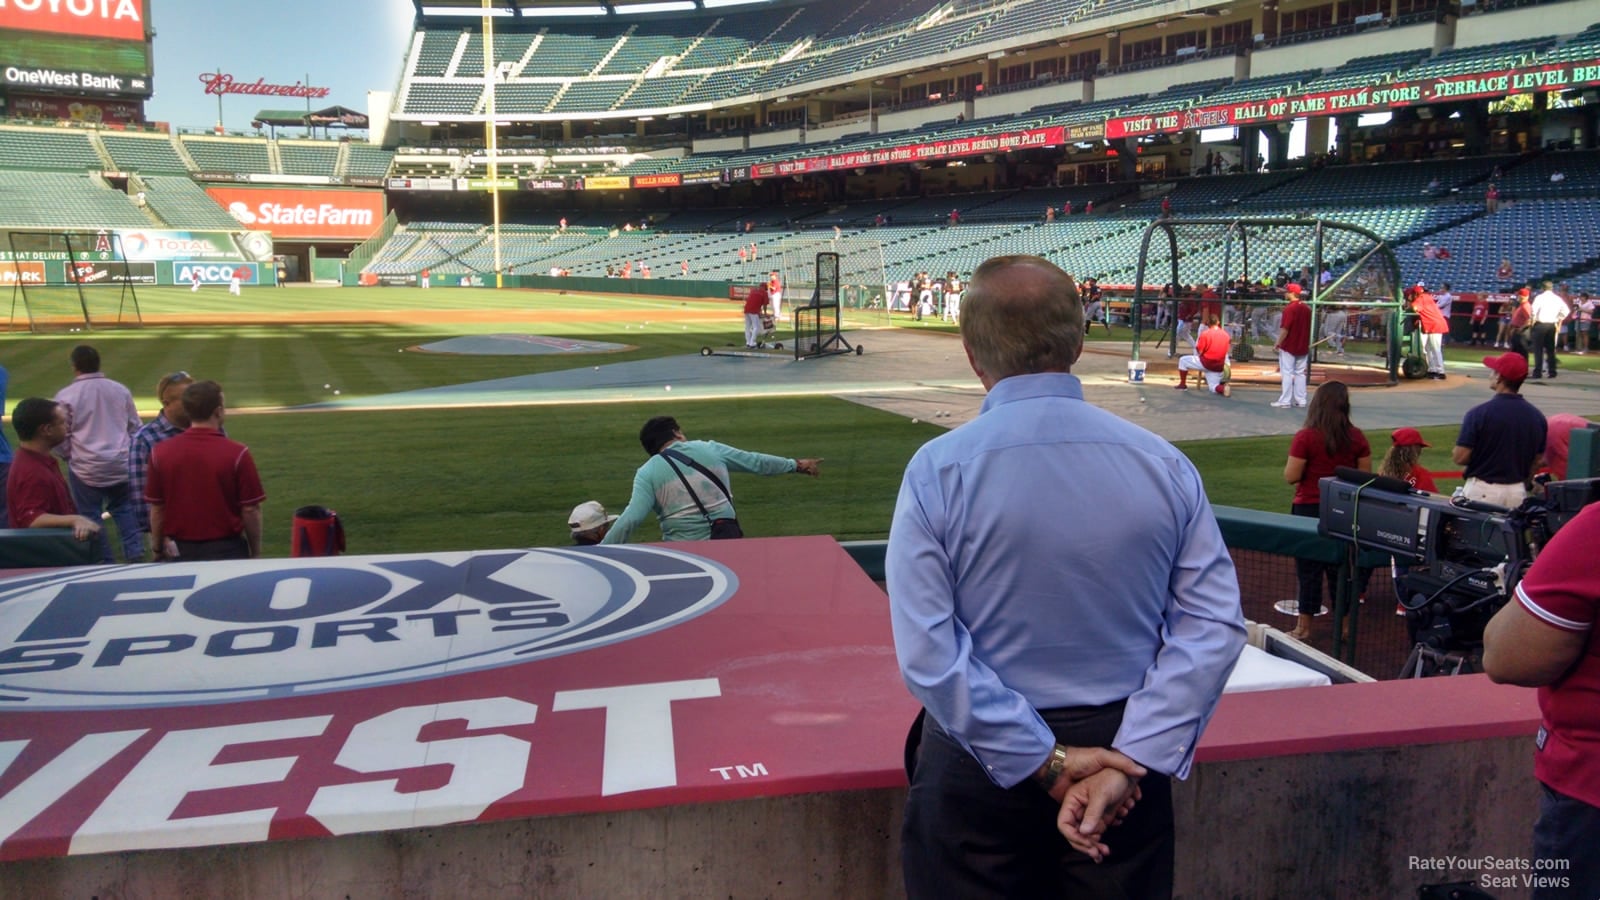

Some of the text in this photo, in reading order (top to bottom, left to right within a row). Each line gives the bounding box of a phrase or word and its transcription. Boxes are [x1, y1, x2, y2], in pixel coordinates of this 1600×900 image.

[0, 0, 140, 22] OYOTA
[5, 67, 79, 87] OneWest
[81, 73, 121, 90] Bank
[199, 73, 331, 98] Budweiser
[1123, 117, 1152, 133] VISIT
[1155, 115, 1178, 130] THE
[1234, 105, 1267, 121] HALL
[1270, 102, 1287, 116] OF
[1290, 97, 1327, 113] FAME
[1330, 91, 1368, 108] TEAM
[1372, 86, 1421, 104] STORE
[1434, 75, 1509, 98] TERRACE
[1513, 69, 1569, 89] LEVEL
[1572, 66, 1600, 83] BE
[778, 164, 794, 173] VISIT
[795, 161, 806, 171] THE
[831, 156, 847, 168] HALL
[847, 156, 855, 165] OF
[855, 154, 871, 163] FAME
[873, 152, 890, 163] TEAM
[890, 149, 911, 160] STORE
[917, 146, 948, 158] TERRACE
[948, 142, 970, 153] LEVEL
[971, 138, 999, 150] BEHIND
[999, 137, 1021, 147] HOME
[1021, 133, 1046, 145] PLATE
[636, 177, 657, 185] WELLS
[155, 238, 214, 250] TOTAL
[35, 251, 71, 260] DELIVER.
[178, 266, 234, 281] ARCO
[15, 551, 560, 643] FOX
[0, 603, 571, 675] SPORTS
[709, 762, 769, 781] TM
